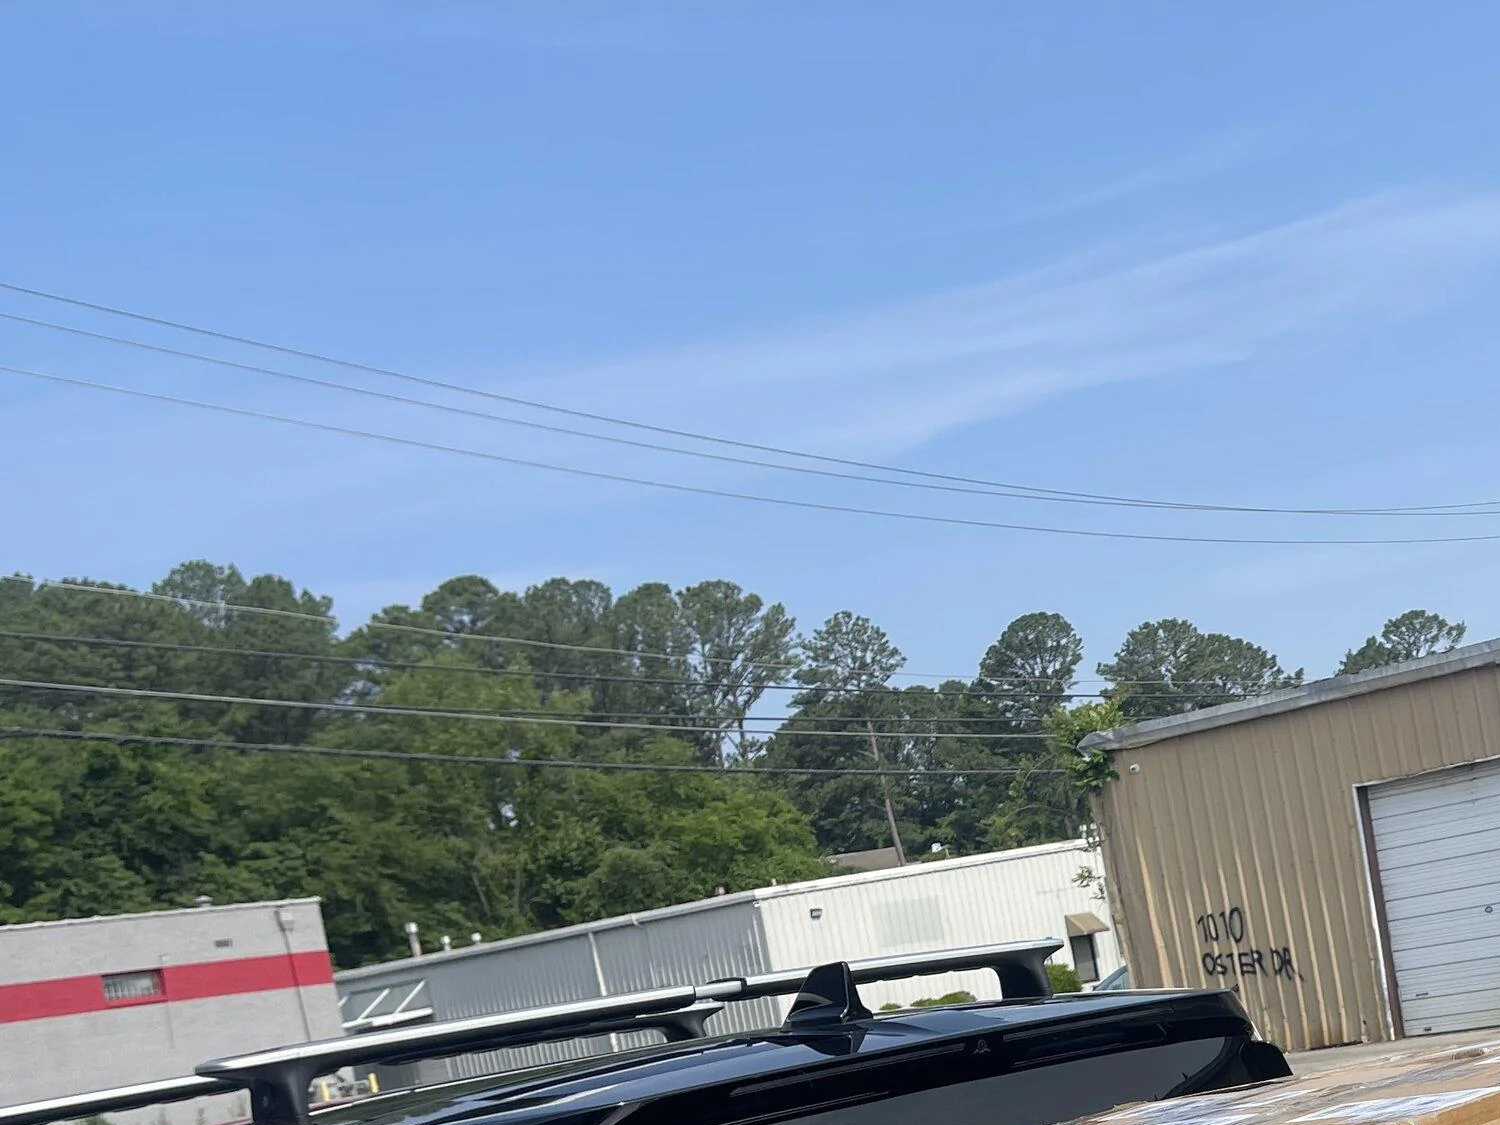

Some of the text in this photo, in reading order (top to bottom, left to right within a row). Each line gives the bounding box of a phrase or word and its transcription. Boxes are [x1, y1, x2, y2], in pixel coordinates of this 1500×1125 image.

[1197, 906, 1243, 943] 1010
[1202, 946, 1304, 981] OSTER DR
